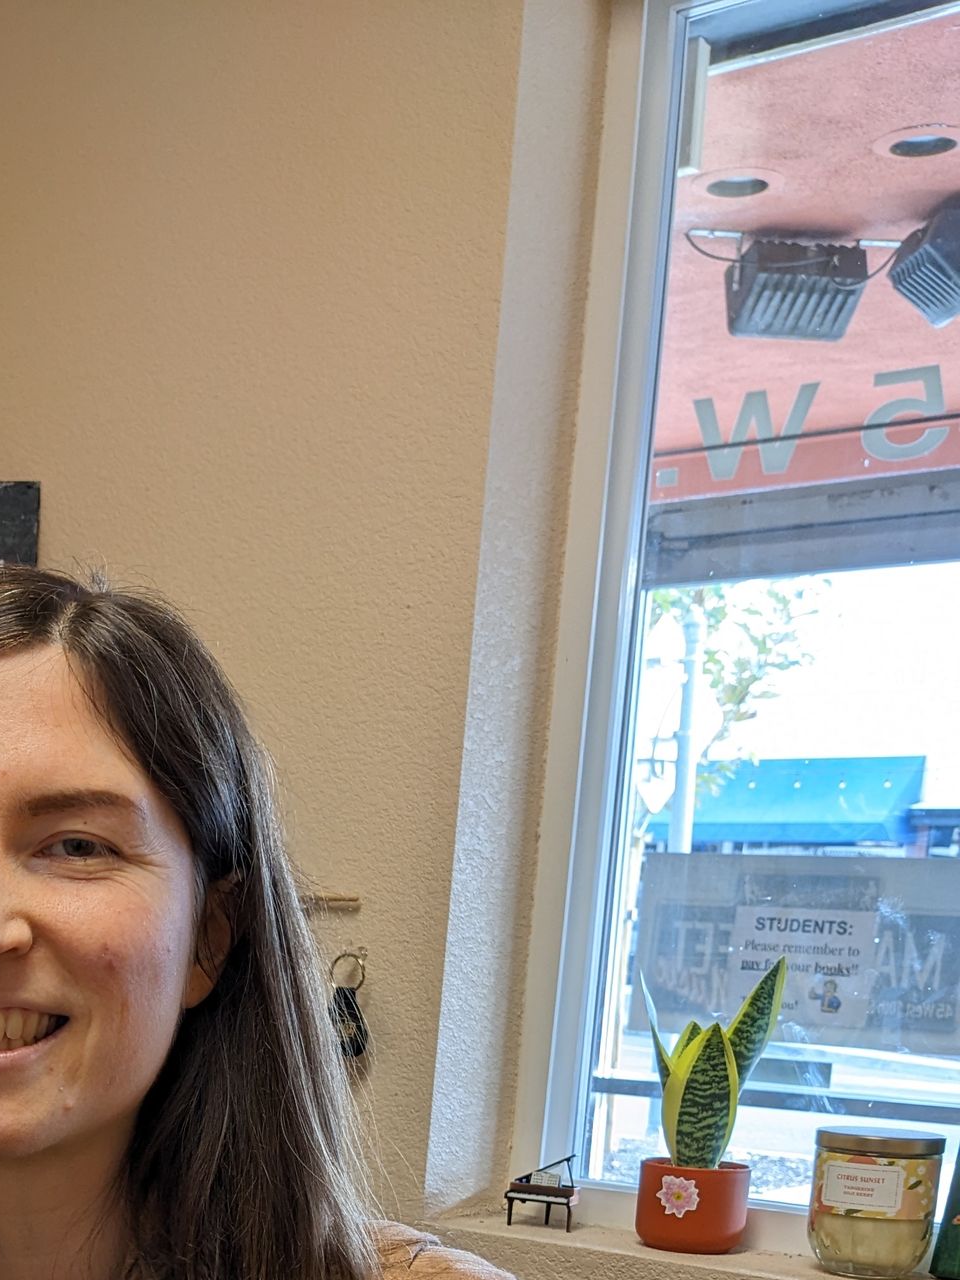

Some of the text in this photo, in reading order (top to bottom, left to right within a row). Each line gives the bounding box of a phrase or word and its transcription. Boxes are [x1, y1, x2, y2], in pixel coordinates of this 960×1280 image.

[754, 916, 855, 937] STUDENTS:
[744, 938, 861, 957] Please remember to
[740, 958, 761, 971] pay
[814, 961, 860, 976] books!!
[780, 1000, 799, 1011] ou!
[837, 1174, 858, 1182] CITRUS
